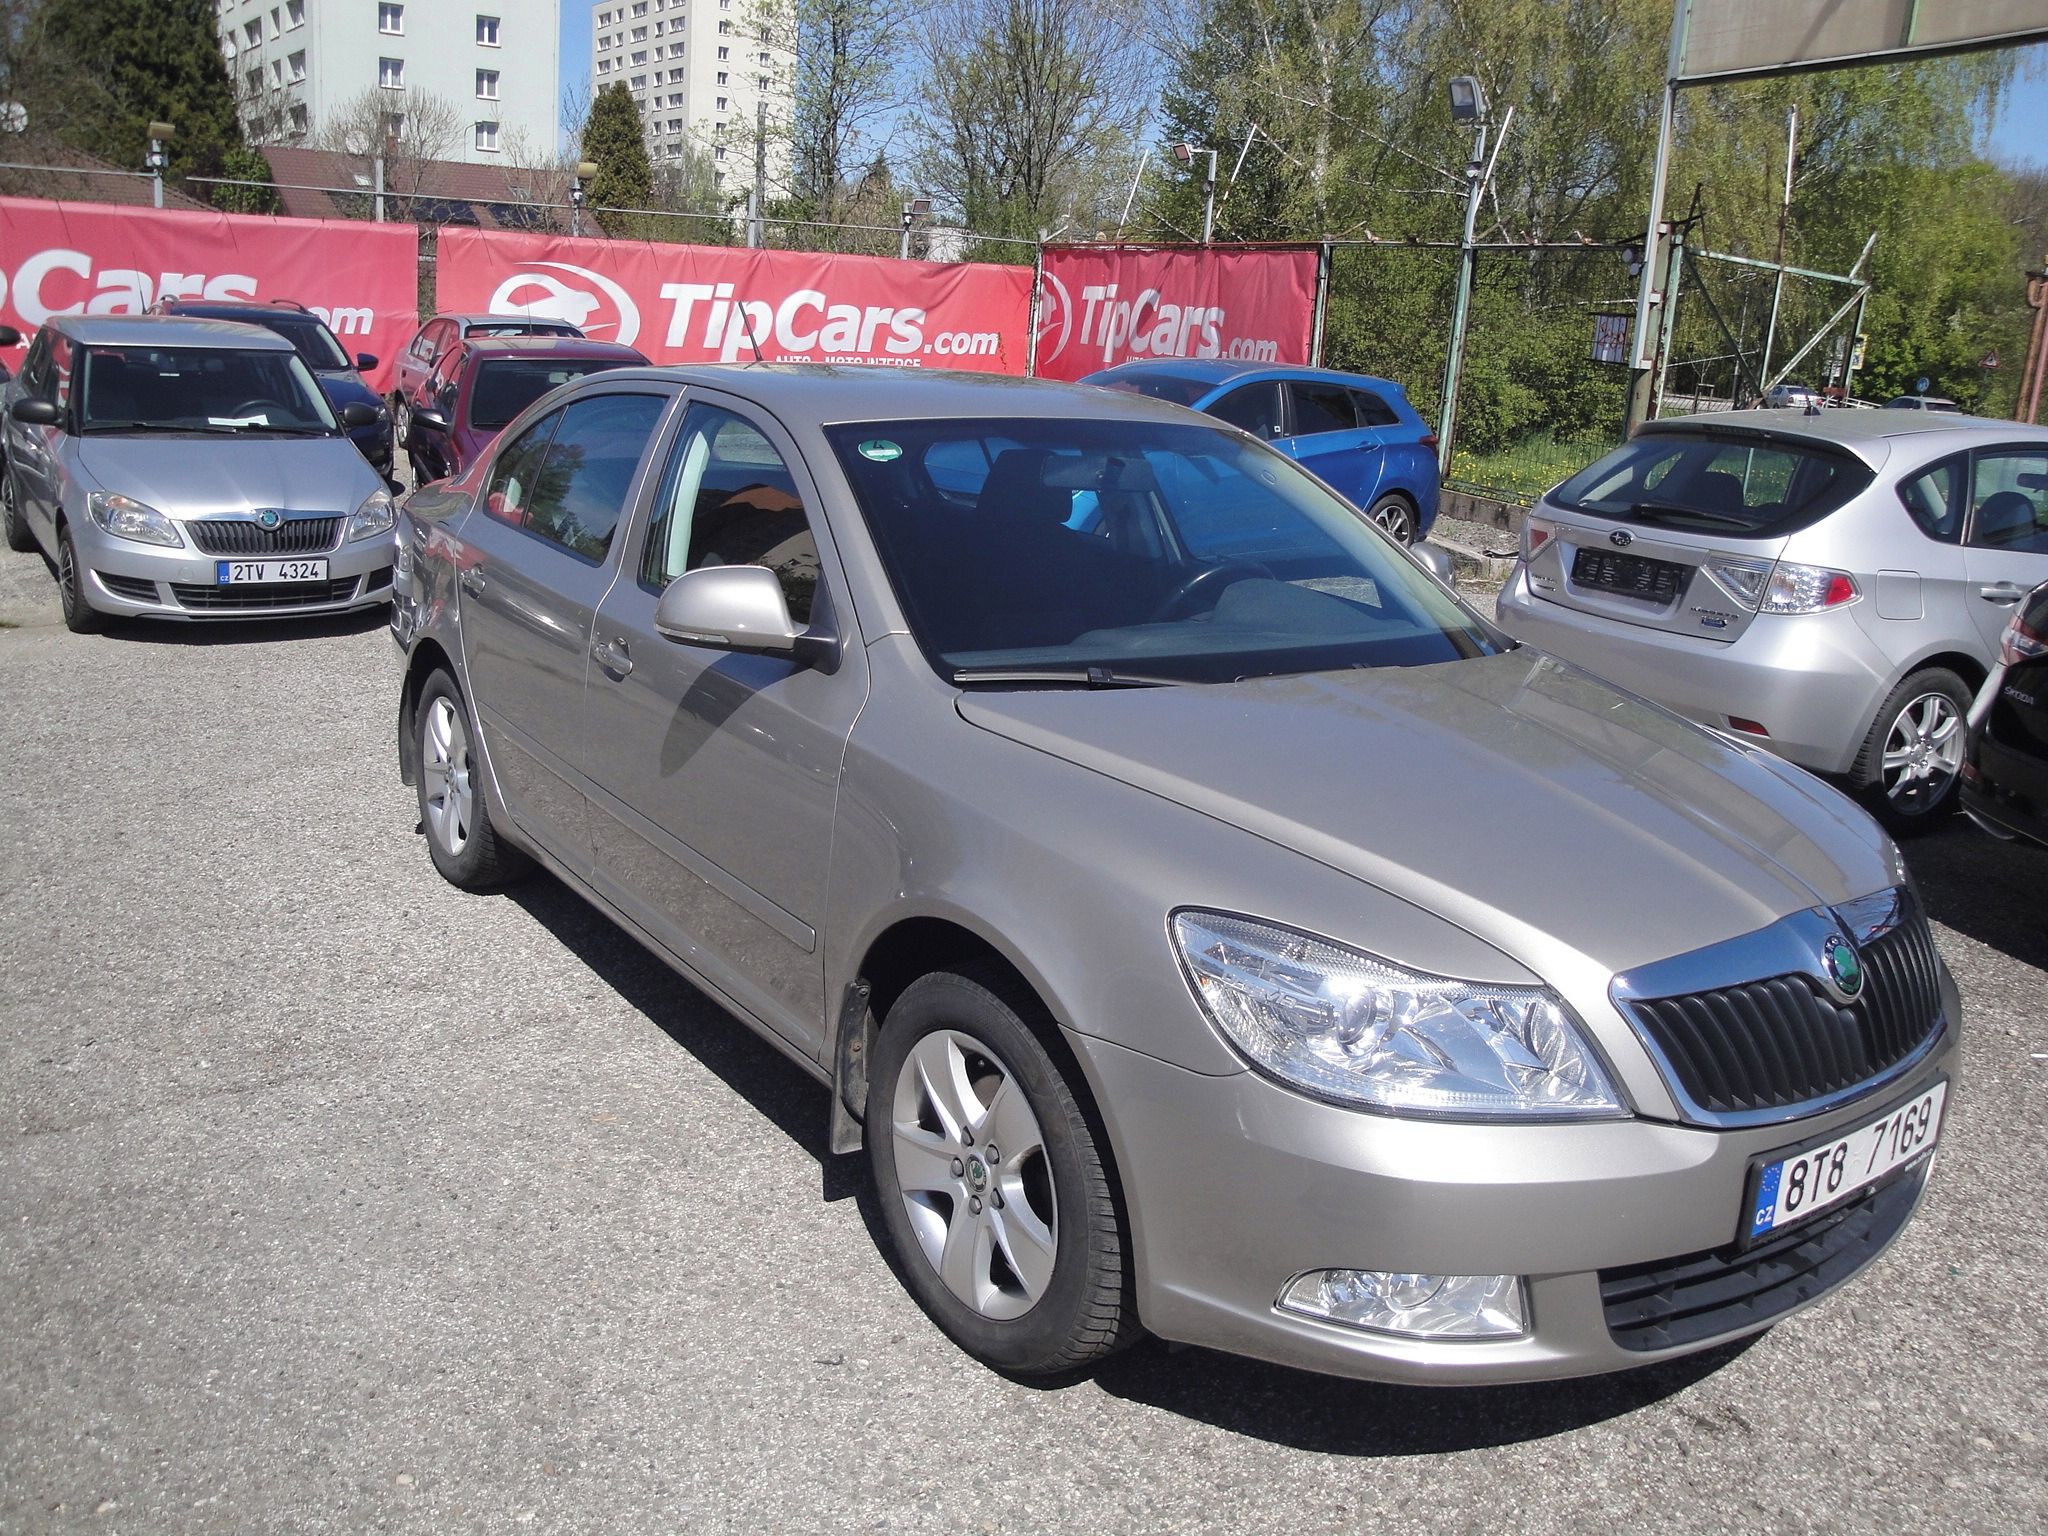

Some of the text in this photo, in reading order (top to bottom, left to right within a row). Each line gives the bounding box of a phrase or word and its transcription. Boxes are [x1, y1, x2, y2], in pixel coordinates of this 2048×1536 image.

[659, 282, 999, 362] TipCars.com
[1080, 283, 1278, 363] TipCars.com
[233, 562, 319, 581] 2TV 4324
[1784, 1095, 1932, 1212] 8T8 7169
[1755, 1205, 1774, 1226] CZ
